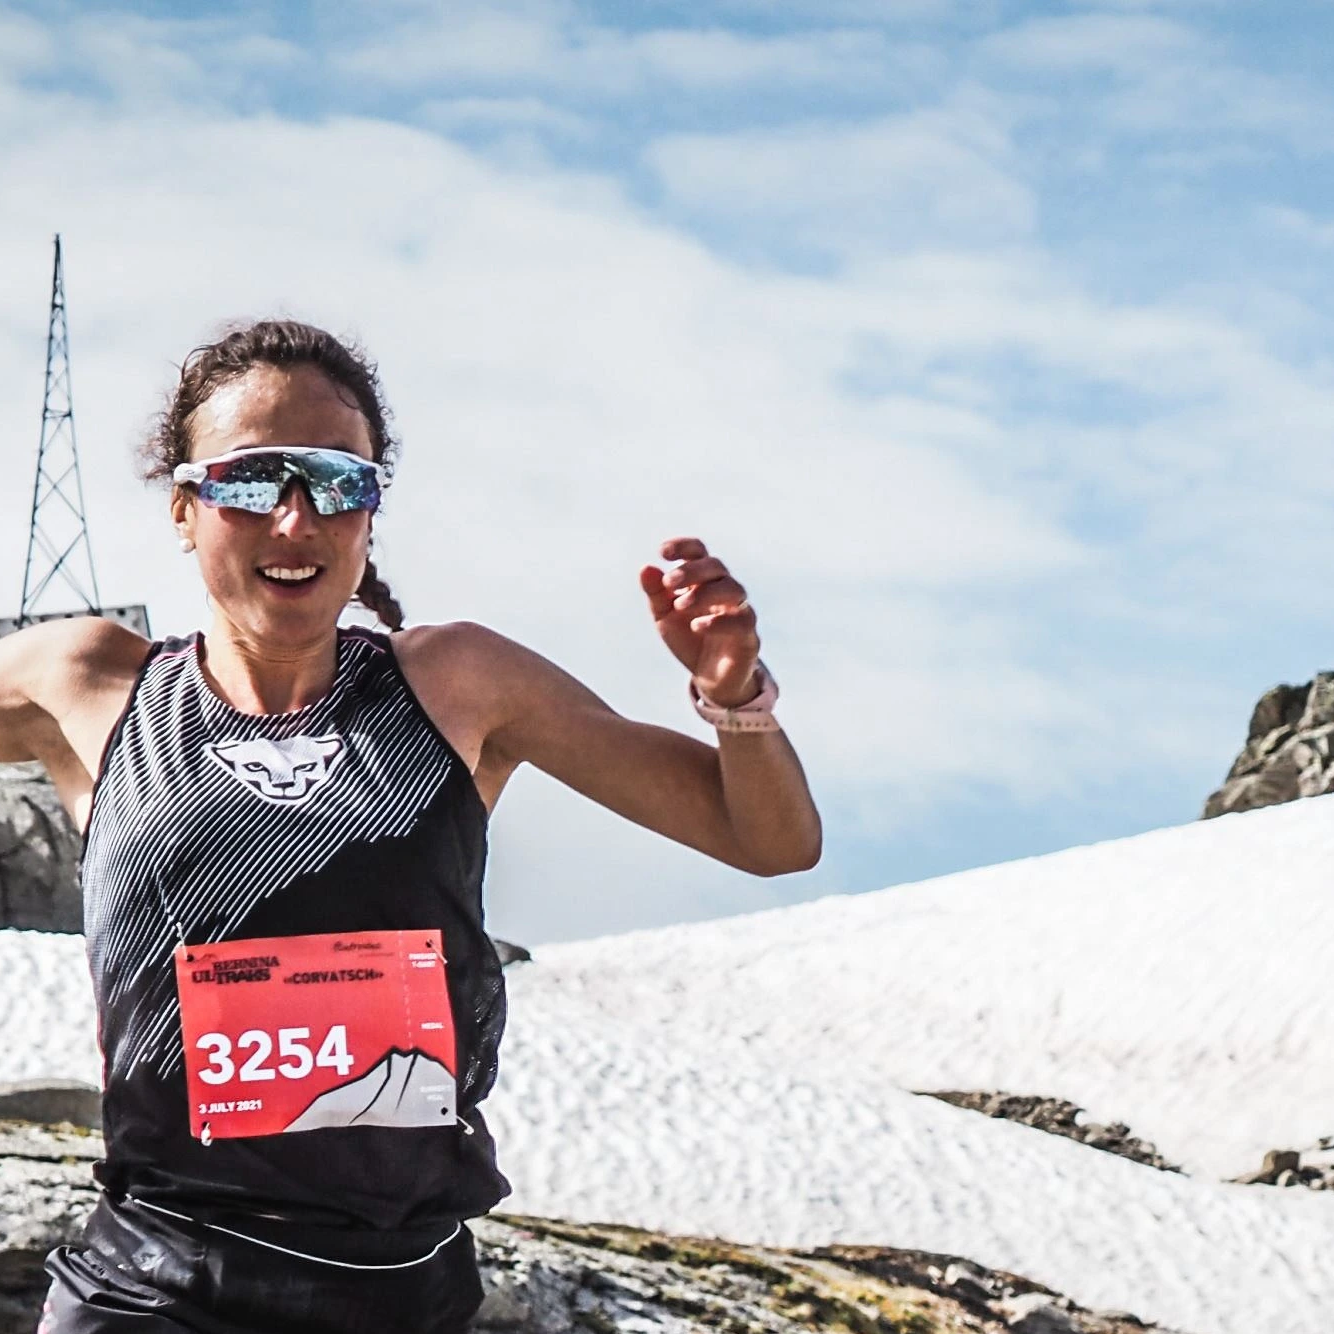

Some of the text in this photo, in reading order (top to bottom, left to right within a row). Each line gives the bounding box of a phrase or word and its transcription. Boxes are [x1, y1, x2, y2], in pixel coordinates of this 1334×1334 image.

[212, 956, 280, 971] BERNINA
[196, 1025, 354, 1085] 3254
[199, 1099, 262, 1114] 3 JULY 2021
